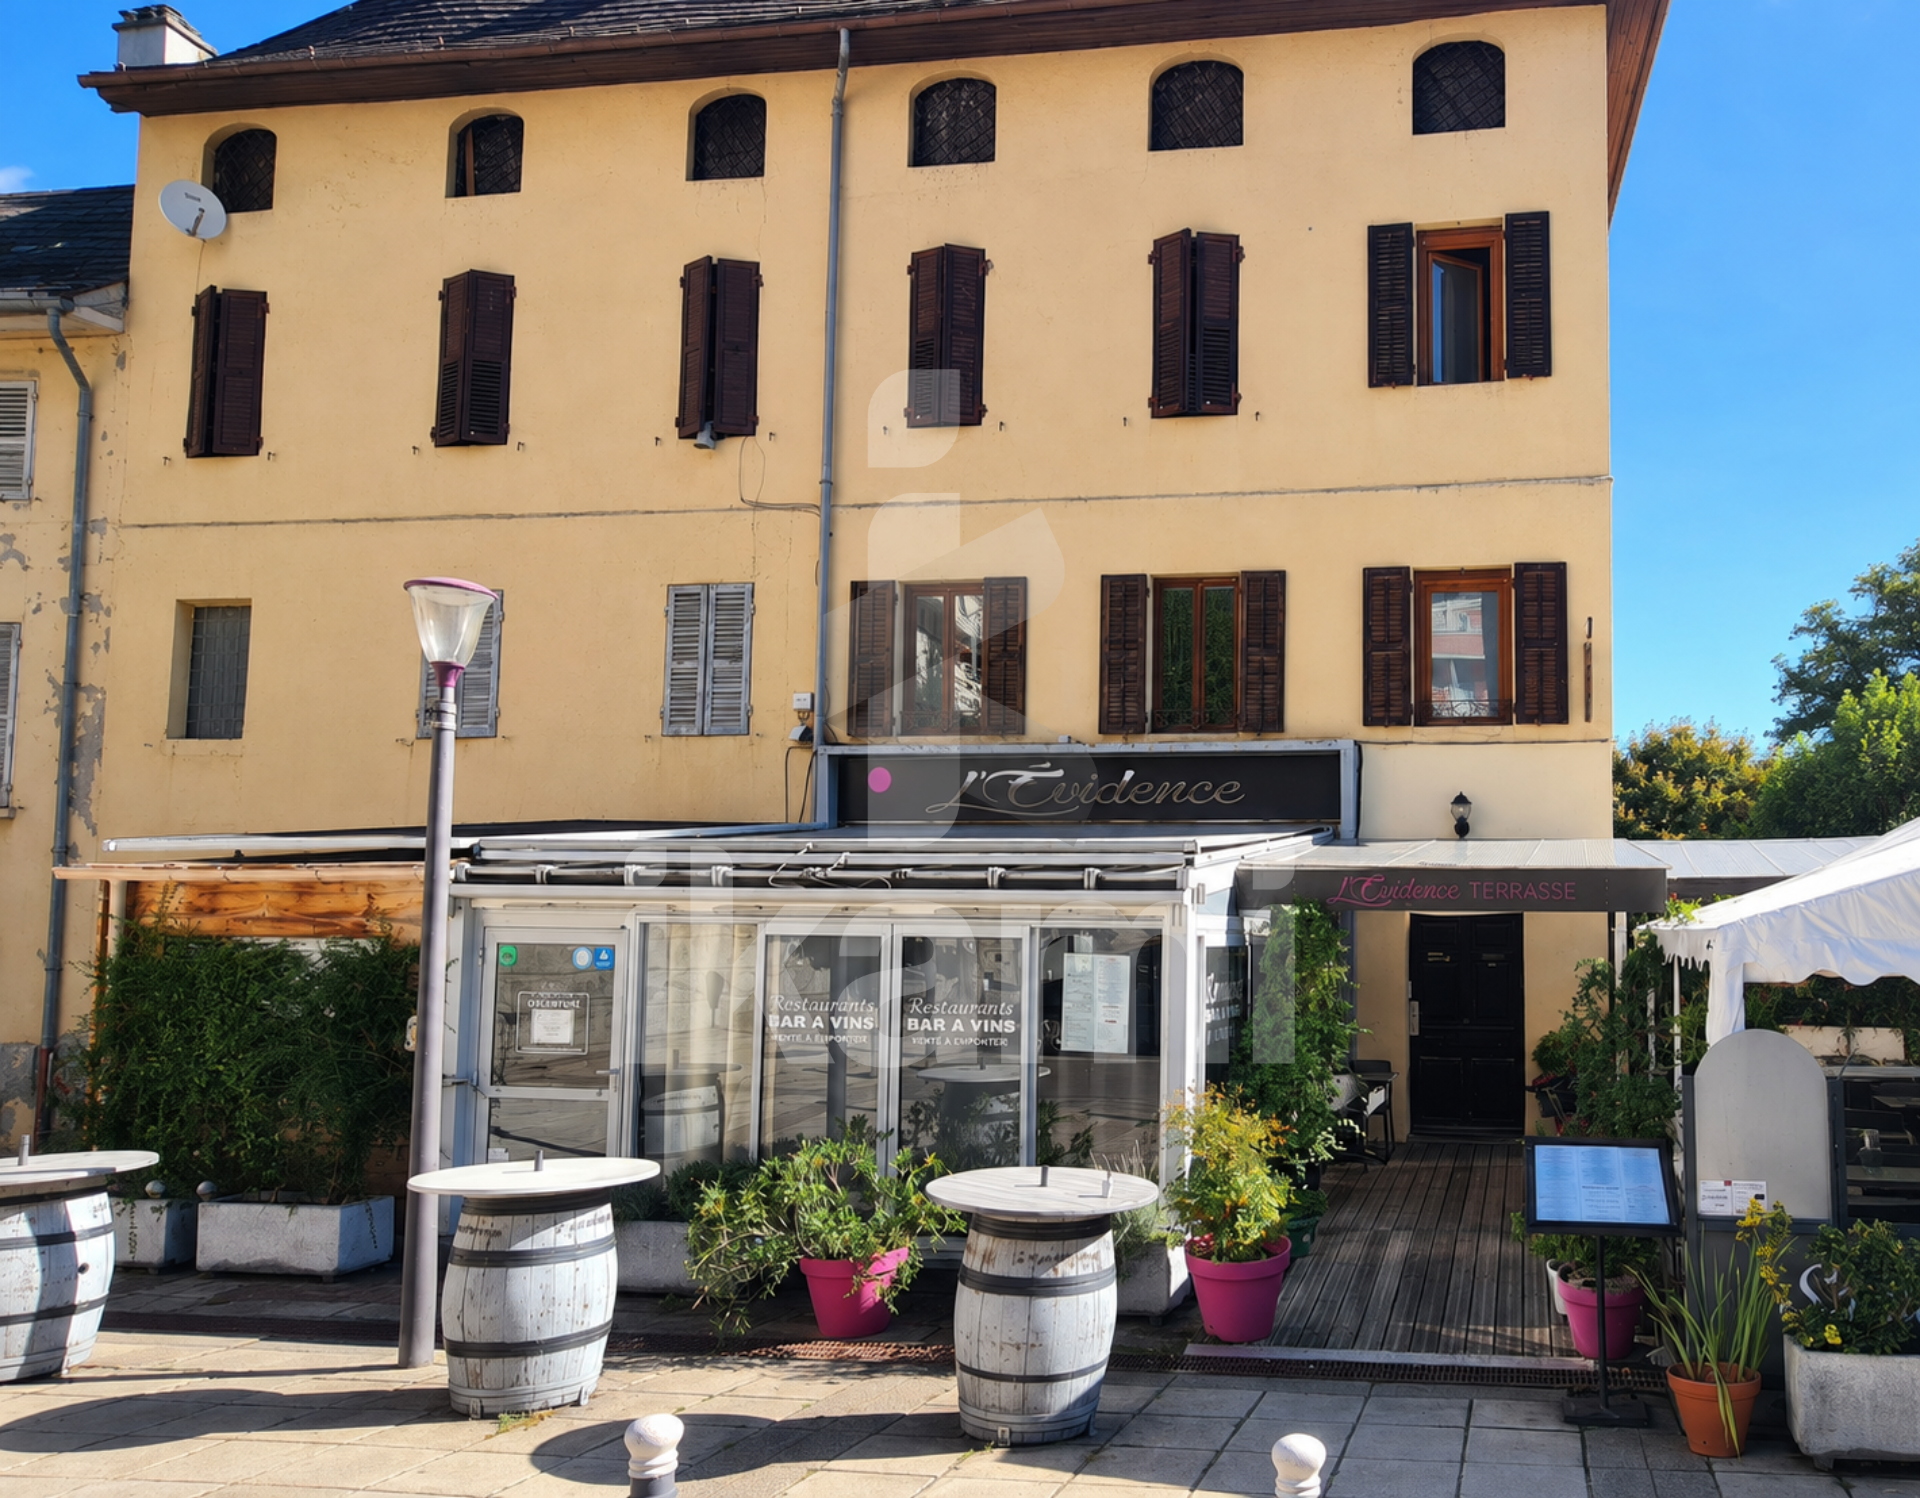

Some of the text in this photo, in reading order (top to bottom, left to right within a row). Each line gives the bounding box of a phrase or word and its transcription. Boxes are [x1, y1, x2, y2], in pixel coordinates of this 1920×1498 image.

[1469, 881, 1576, 900] TERRASSE
[769, 994, 875, 1013] Restaurants
[908, 996, 1014, 1015] Restaurants
[768, 1014, 806, 1028] BAR
[830, 1016, 875, 1030] VINS
[907, 1018, 946, 1031] BAR
[970, 1019, 1016, 1033] VINS
